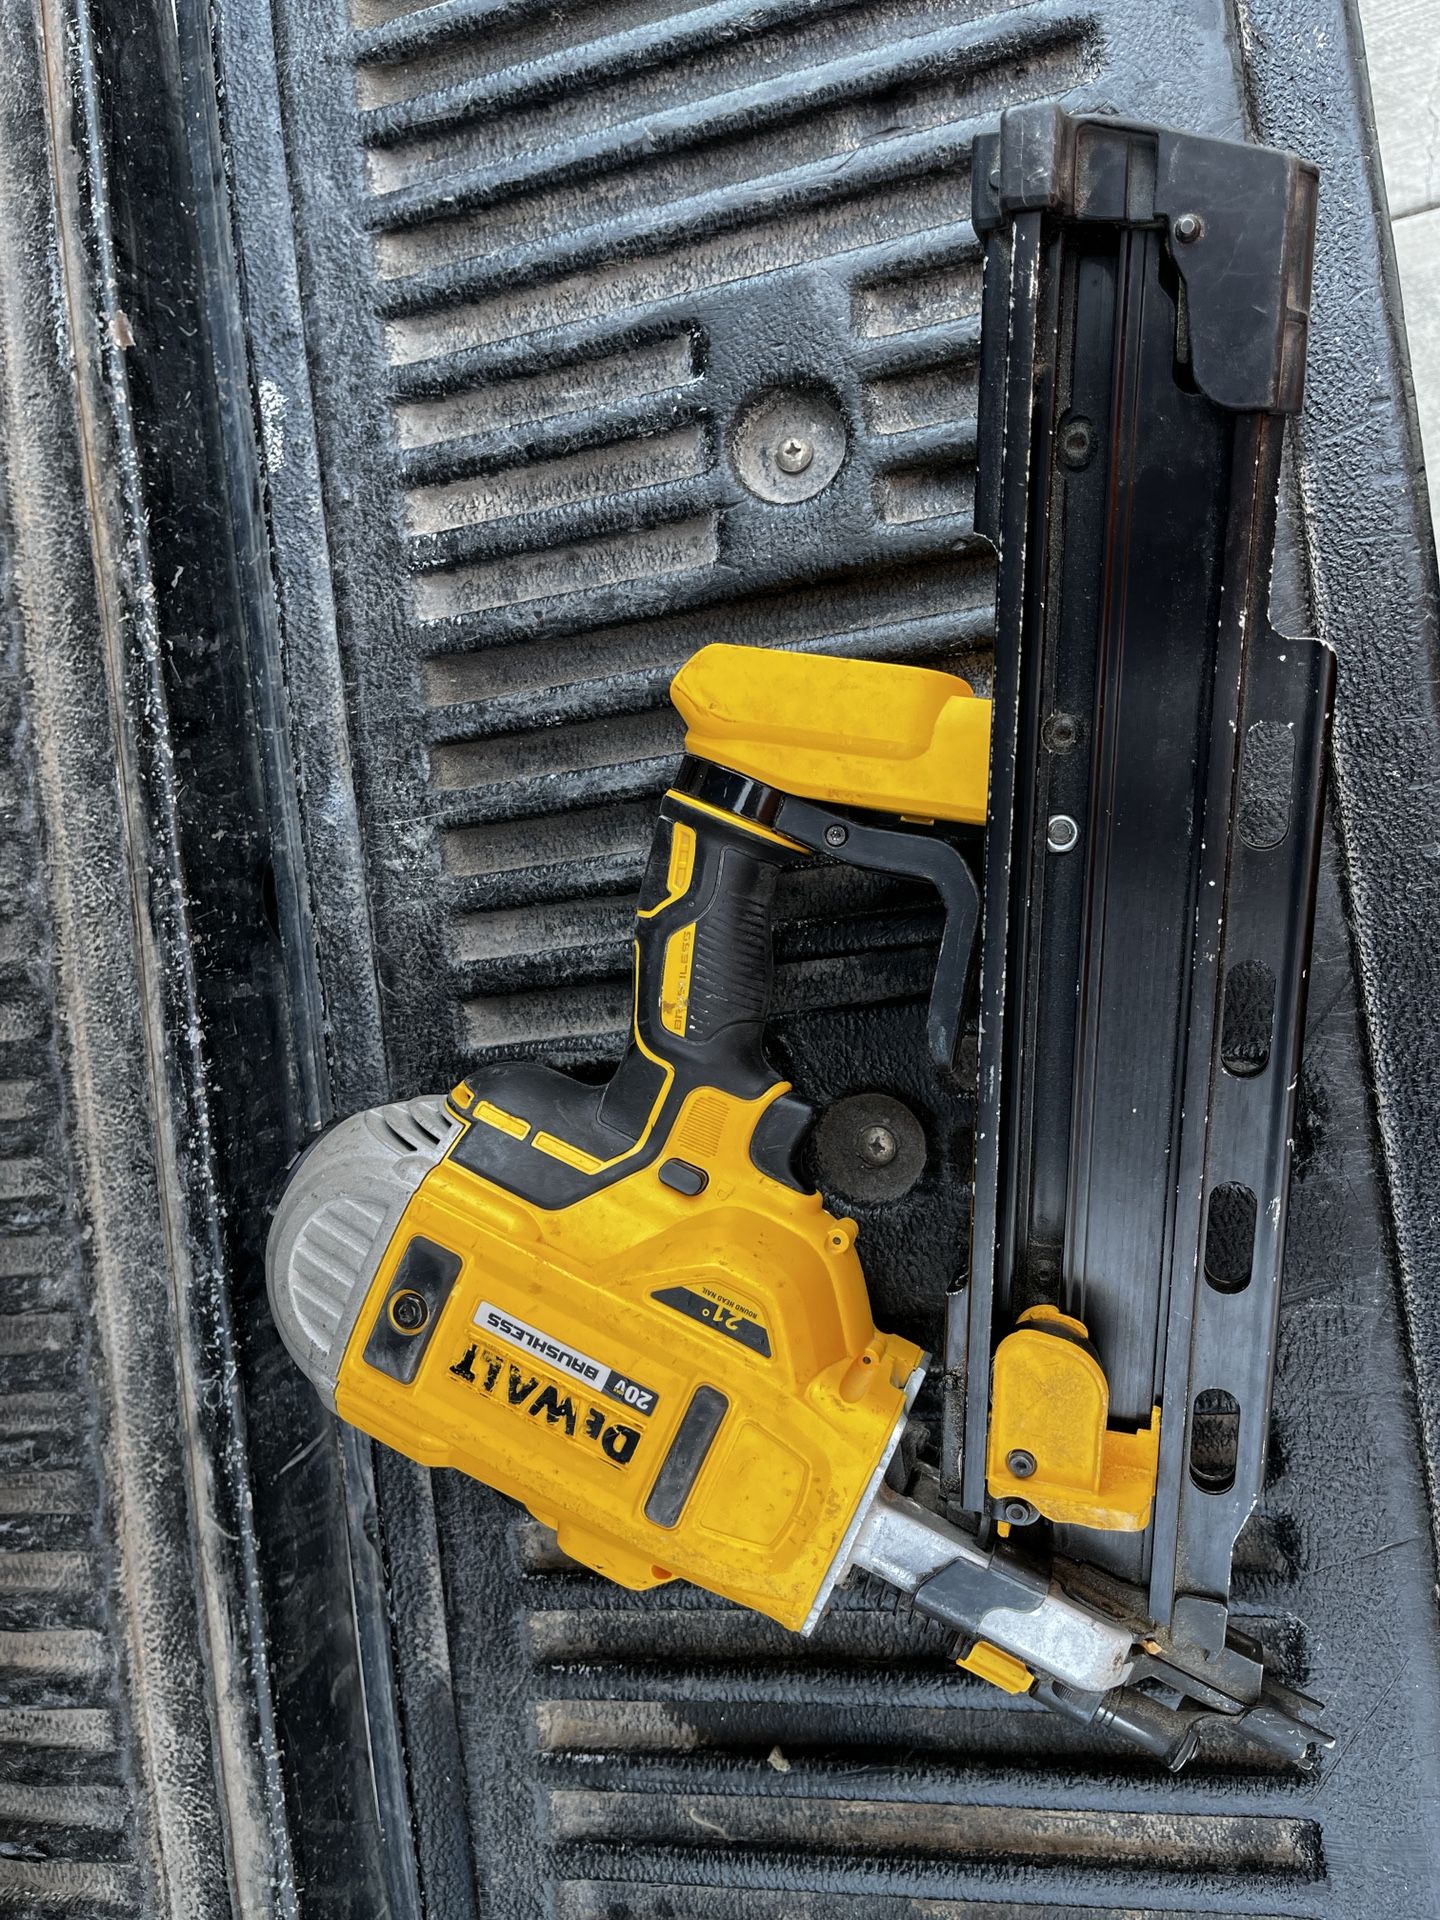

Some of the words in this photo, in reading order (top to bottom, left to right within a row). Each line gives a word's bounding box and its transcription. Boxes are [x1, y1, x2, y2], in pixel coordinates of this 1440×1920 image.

[673, 931, 691, 1031] BRSLESS
[702, 1286, 716, 1299] NAIL
[717, 1295, 735, 1309] HEAD
[735, 1304, 758, 1319] ROUND
[487, 1312, 600, 1381] BRUSHLESS
[449, 1343, 642, 1466] DEWALT
